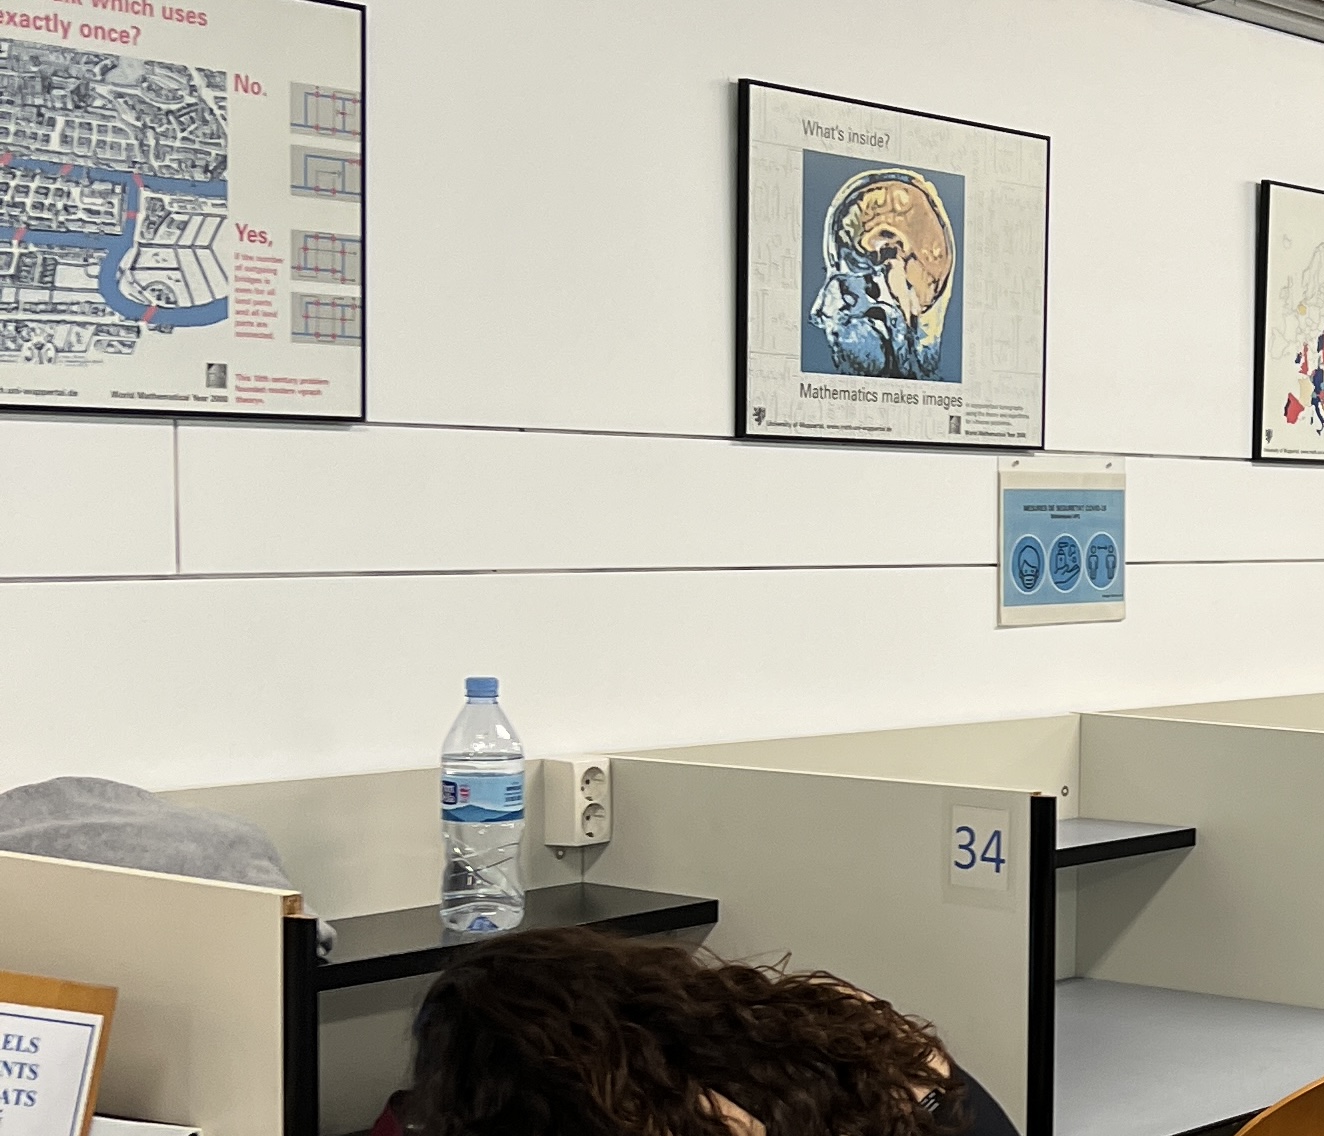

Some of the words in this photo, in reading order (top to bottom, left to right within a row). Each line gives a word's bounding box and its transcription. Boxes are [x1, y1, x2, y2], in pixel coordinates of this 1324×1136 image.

[162, 5, 208, 26] uses
[79, 22, 141, 45] once?
[234, 73, 267, 96] No.
[802, 119, 845, 141] What's
[847, 127, 890, 149] inside?
[235, 222, 273, 248] Yes,
[800, 383, 878, 403] Mathematics
[882, 389, 919, 405] makes
[922, 390, 963, 410] images
[954, 825, 1006, 873] 34
